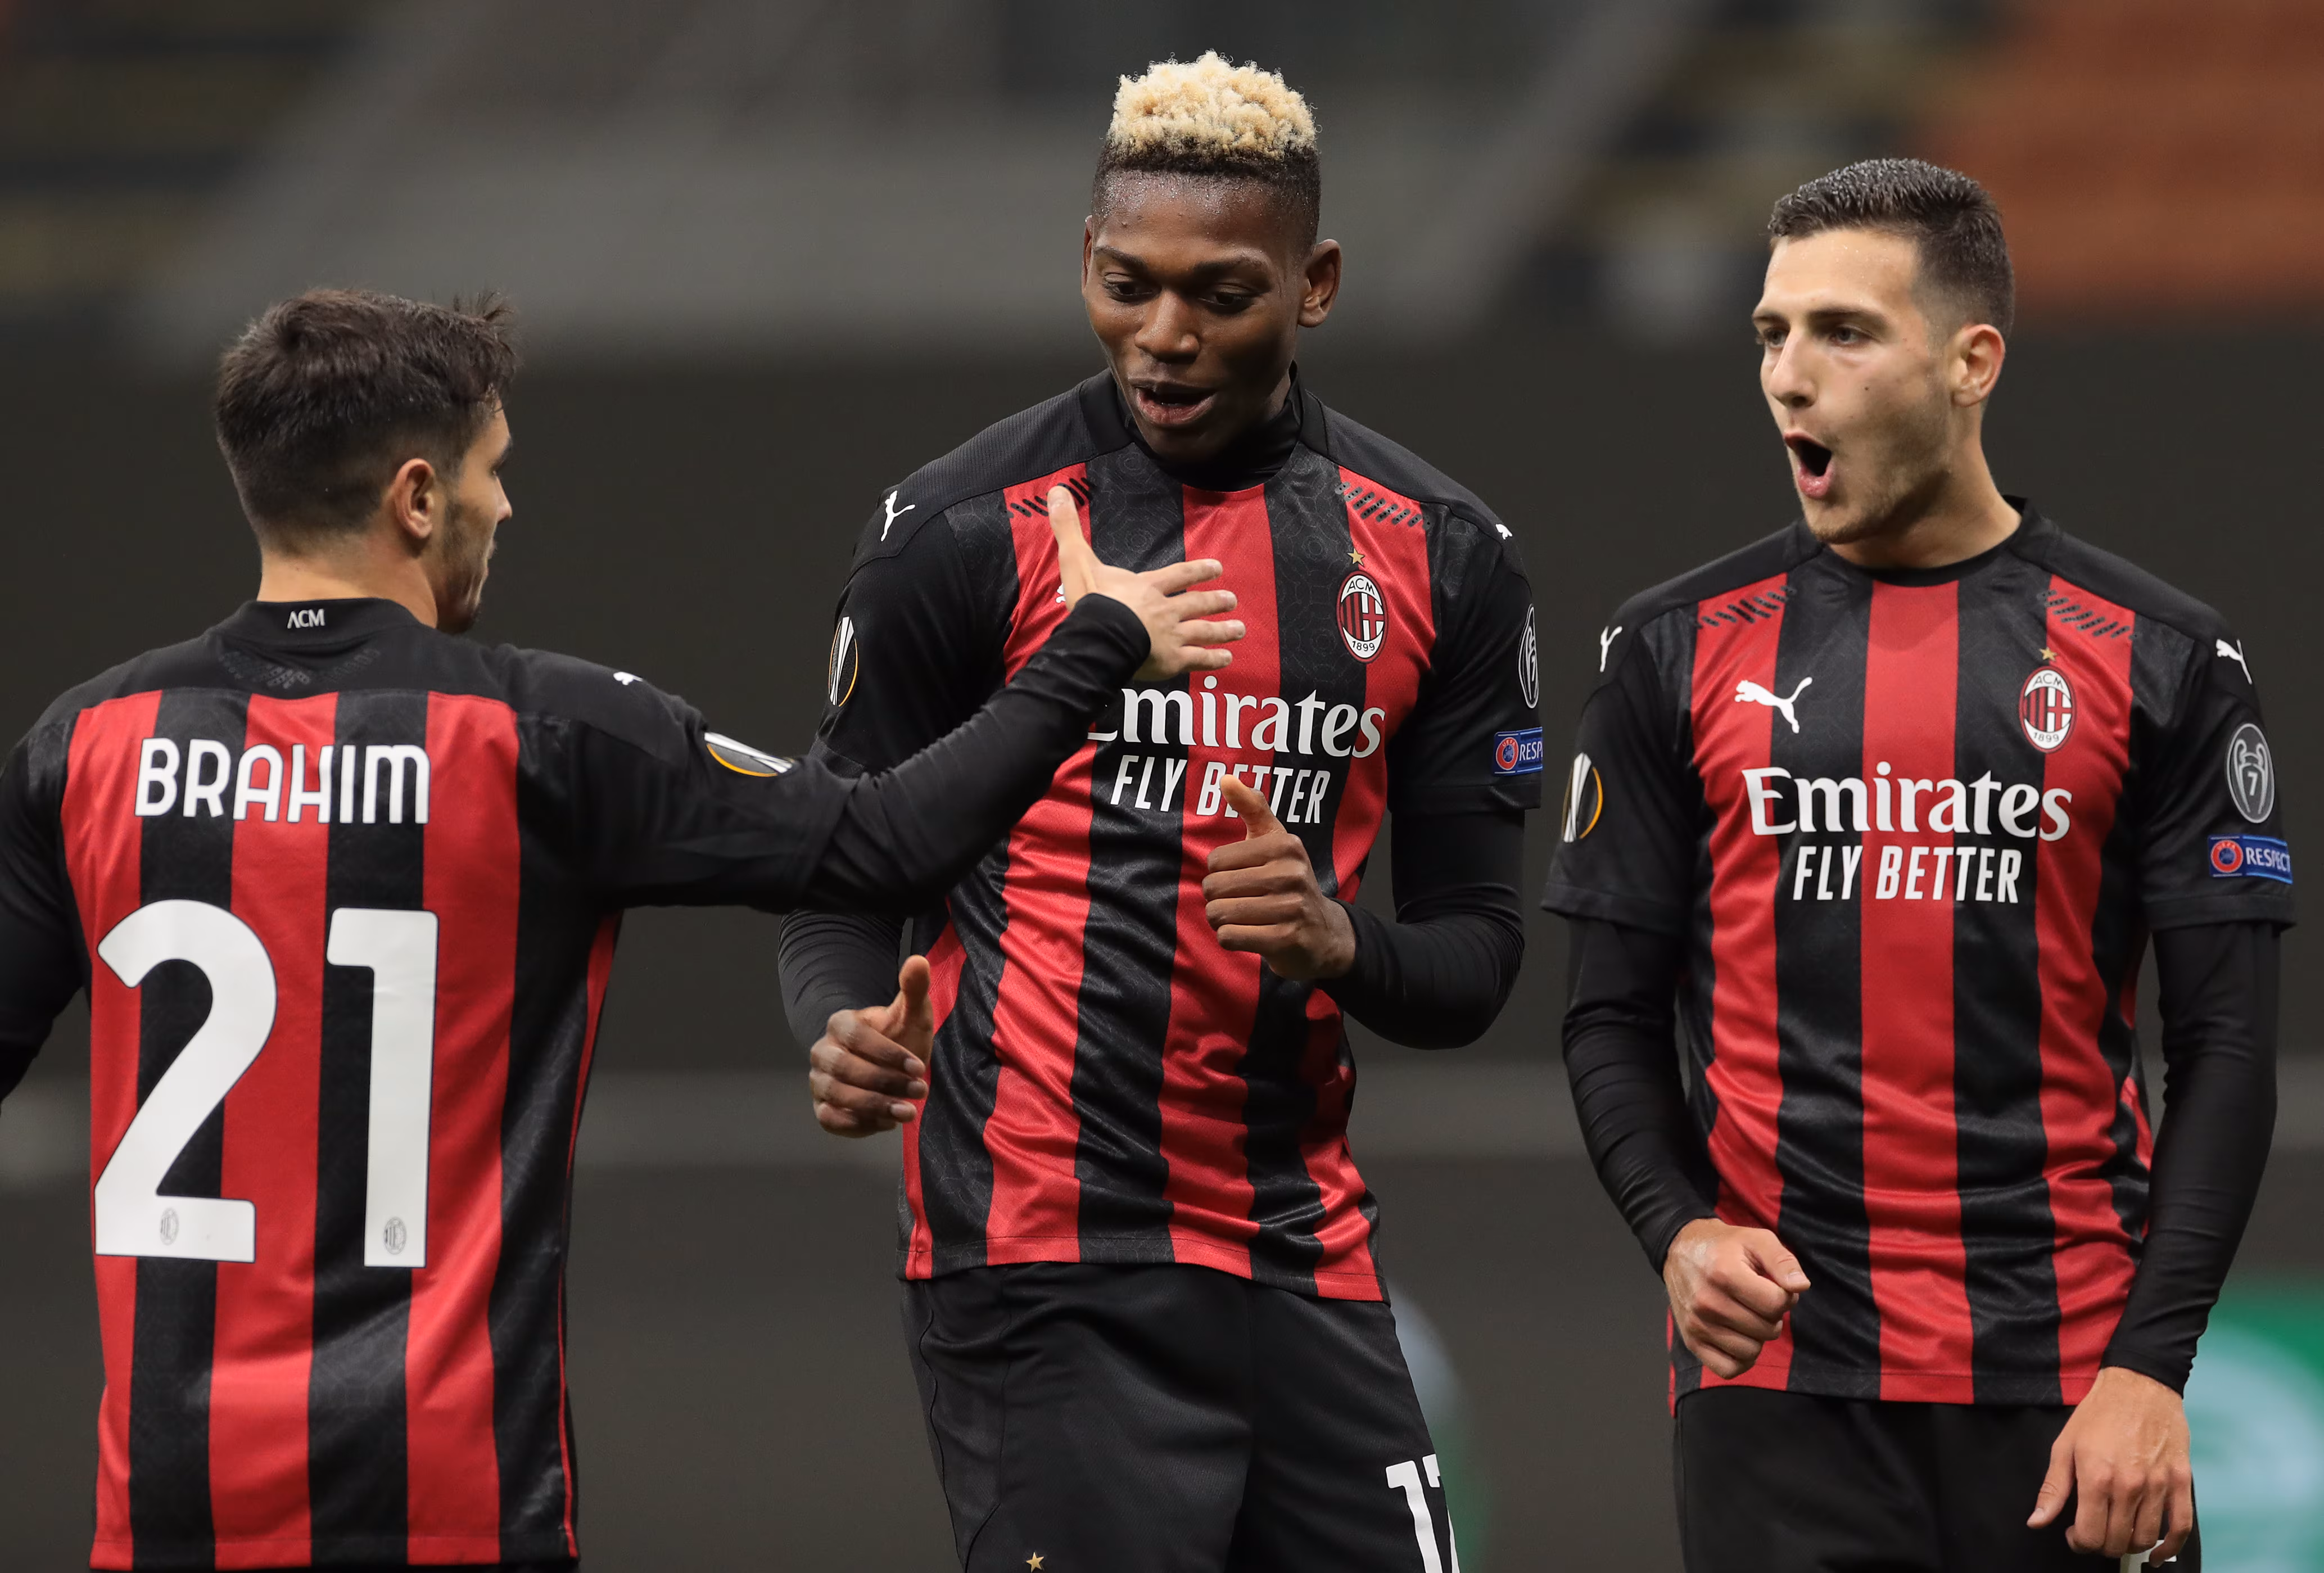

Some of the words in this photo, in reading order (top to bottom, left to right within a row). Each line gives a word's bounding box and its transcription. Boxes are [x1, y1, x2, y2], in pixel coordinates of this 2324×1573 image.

[1347, 578, 1375, 596] ACM
[287, 608, 325, 629] ACM
[1351, 640, 1376, 652] 1899
[2033, 673, 2064, 689] ACM
[1087, 676, 1385, 758] mirates
[2033, 732, 2059, 743] 1899
[1520, 741, 1543, 761] RESP
[135, 738, 430, 824] BRAHIM
[1110, 754, 1187, 812] FLY
[2248, 771, 2258, 796] 7
[1742, 761, 2073, 841] Emirates
[2245, 847, 2291, 873] RESPECT
[1793, 846, 1863, 901] FLY
[1875, 846, 2022, 903] BETTER
[94, 899, 438, 1268] 21
